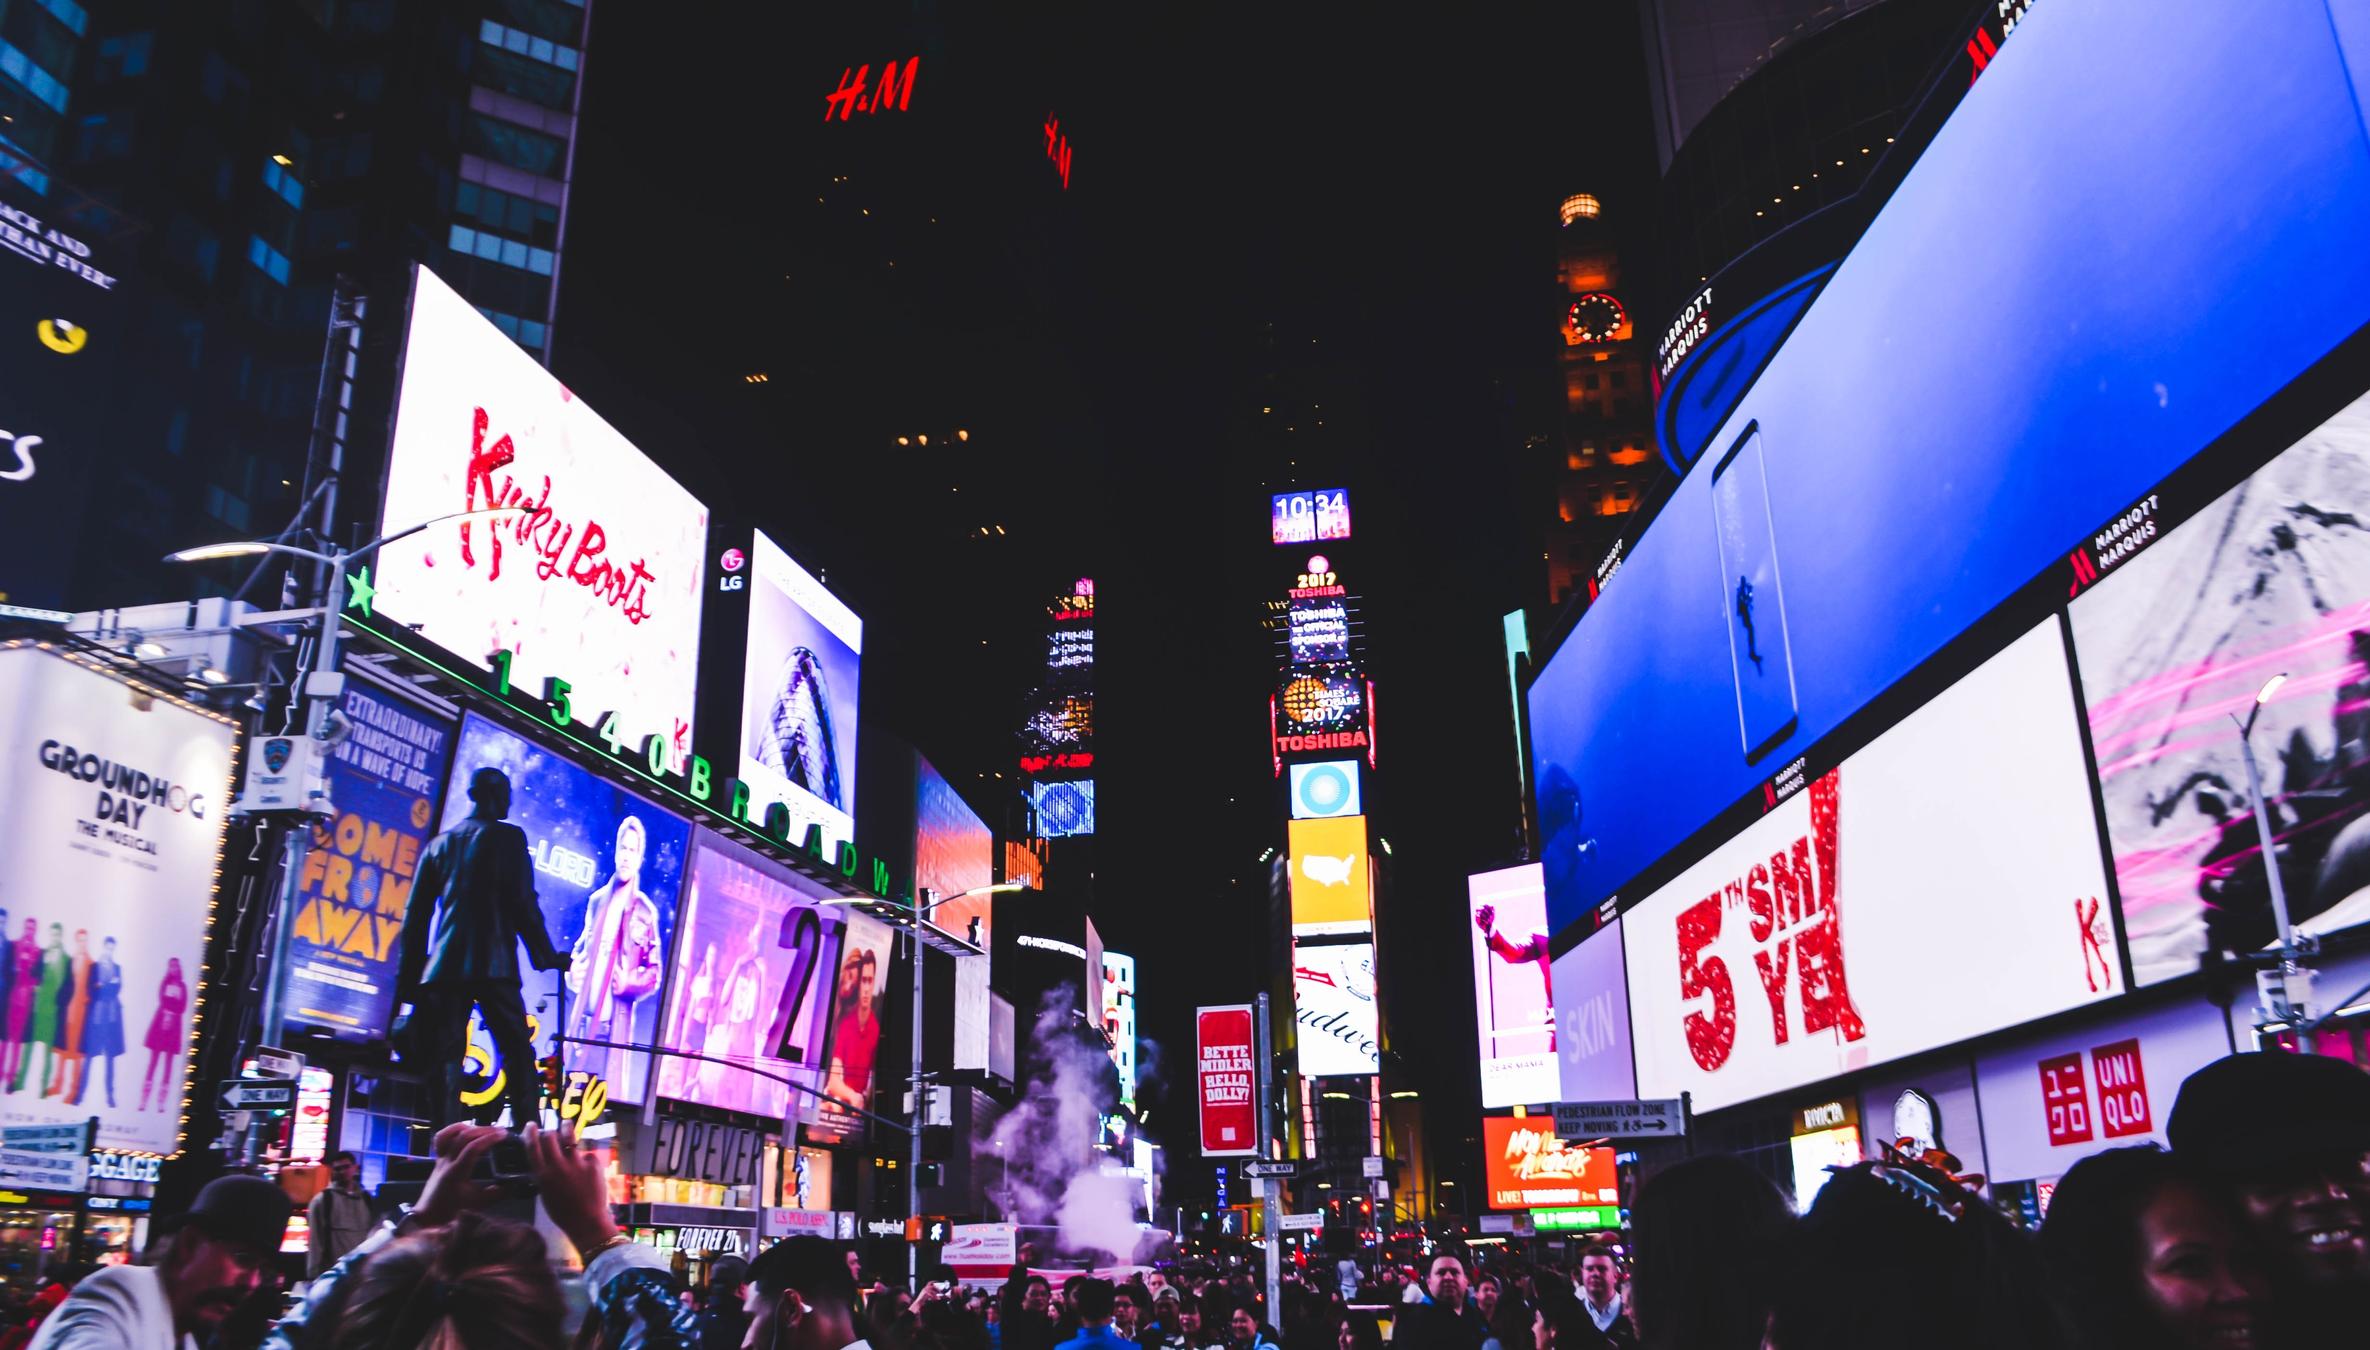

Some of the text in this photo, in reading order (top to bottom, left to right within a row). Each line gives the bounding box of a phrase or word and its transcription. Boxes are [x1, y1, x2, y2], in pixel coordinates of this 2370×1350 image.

[825, 56, 920, 122] H&M
[44, 229, 91, 258] AND
[1659, 287, 1712, 360] MARRIOTT
[1661, 317, 1708, 380] MARQUIS
[459, 405, 572, 583] Kinky
[1276, 492, 1346, 520] 10:34
[2095, 494, 2158, 551] MARRIOTT
[1597, 538, 1623, 578] MARRIOTT
[2098, 520, 2156, 569] MARQUIS
[567, 520, 656, 625] Boots
[720, 576, 743, 591] LG
[1297, 572, 1337, 589] 2017
[1288, 585, 1345, 599] TOSHIBA
[1290, 608, 1346, 622] TOSHIBA
[1312, 689, 1345, 700] TIMES
[1318, 694, 1360, 708] SQUARE
[486, 648, 668, 777] 1540
[1301, 706, 1344, 723] 2017
[352, 721, 413, 764] TRANSPORTS
[1277, 731, 1368, 752] TOSHIBA
[349, 745, 361, 766] A
[361, 749, 393, 779] WAVE
[1775, 757, 1806, 785] MARRIOTT
[39, 739, 205, 820] GROUNDHOG
[1776, 773, 1805, 799] MARQUIS
[95, 790, 147, 832] DAY
[77, 818, 99, 838] THE
[103, 828, 158, 856] MUSICAL
[299, 848, 412, 920] FROM
[292, 897, 402, 963] AWAY
[762, 906, 848, 1070] 21
[1566, 989, 1616, 1065] SKIN
[1200, 1058, 1253, 1073] MIDLER
[1203, 1045, 1249, 1060] BETTE
[2098, 1052, 2136, 1089] UNI
[241, 1088, 288, 1101] ONE WAY
[1205, 1087, 1250, 1102] DOLLY!
[1557, 1099, 1665, 1119] PEDESTRIAN FLOW ZONE
[2105, 1090, 2145, 1132] QLO
[1557, 1120, 1618, 1135] KEEP MOVING
[651, 1119, 761, 1186] FOREVER
[1258, 1163, 1293, 1173] ONE WAY
[1497, 1190, 1520, 1203] LIVE!
[676, 1227, 739, 1251] FOREVER 21
